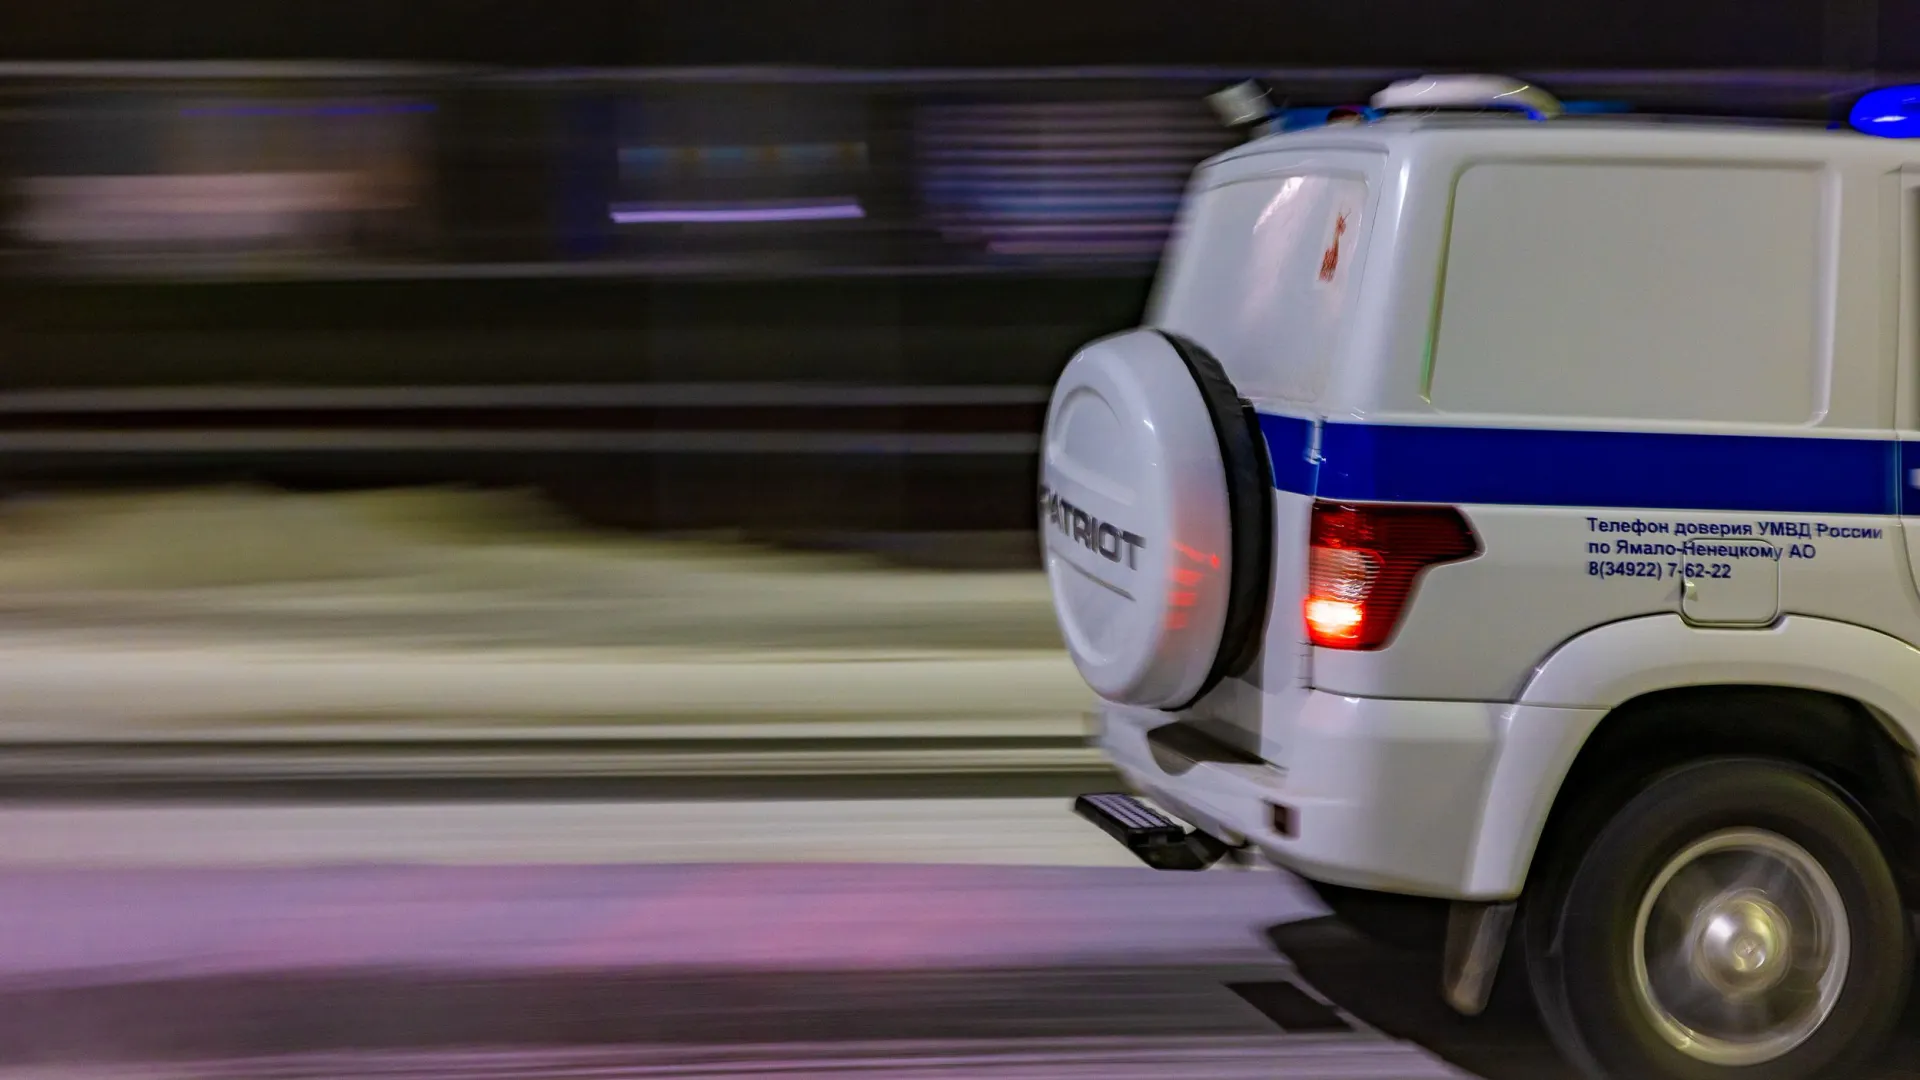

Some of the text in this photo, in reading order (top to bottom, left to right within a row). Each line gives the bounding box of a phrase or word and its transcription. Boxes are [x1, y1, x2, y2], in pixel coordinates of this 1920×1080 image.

[1586, 517, 1883, 540] Телефон доверия УМВД России
[1588, 539, 1817, 561] по Ямало-Ненецкому АО
[1588, 560, 1732, 580] 8(34922) 7-62-22
